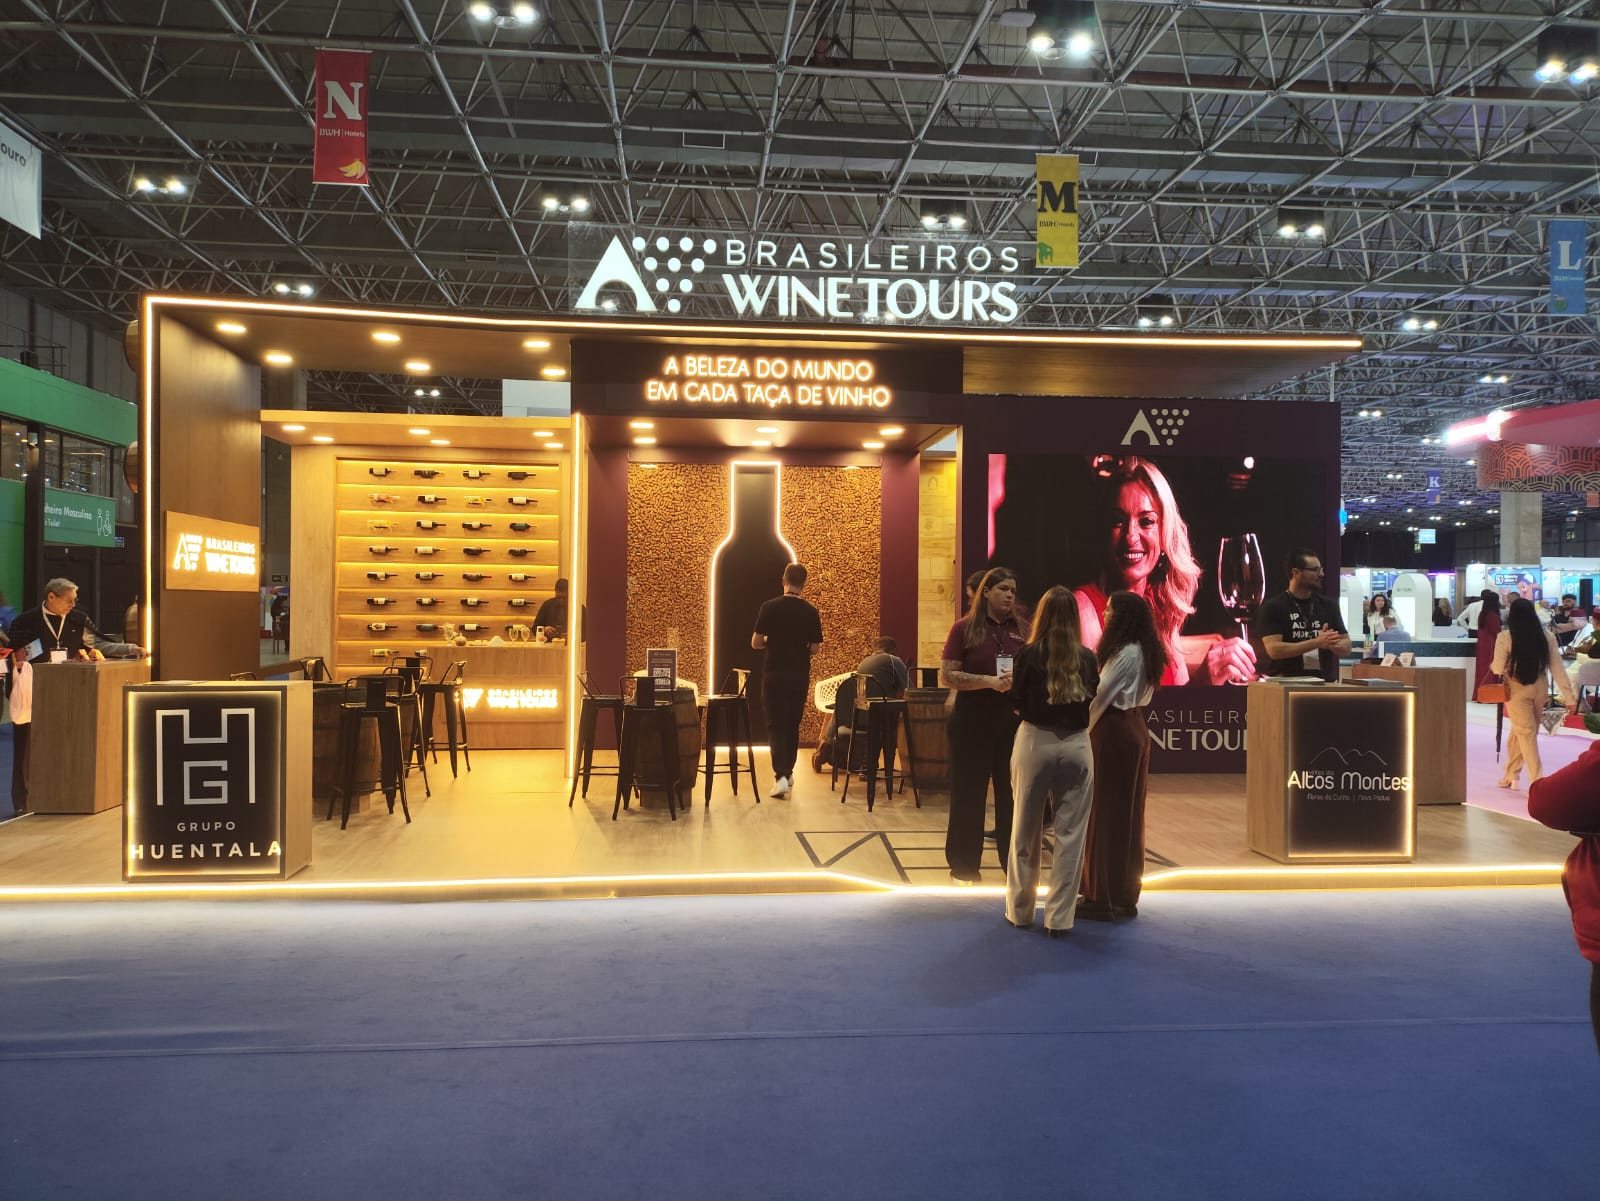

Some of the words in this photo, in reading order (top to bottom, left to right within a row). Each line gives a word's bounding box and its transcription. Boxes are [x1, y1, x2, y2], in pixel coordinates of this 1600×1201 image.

[323, 81, 364, 120] N
[319, 128, 341, 137] BWH
[1037, 181, 1078, 213] M
[726, 239, 1019, 272] BRASILEIROS
[1557, 240, 1582, 271] L
[663, 355, 679, 375] A
[685, 355, 750, 378] BELEZA
[756, 358, 788, 379] DO
[793, 359, 874, 382] MUNDO
[647, 381, 678, 401] EM
[684, 382, 738, 403] CADA
[742, 384, 792, 408] TAÇA
[798, 385, 823, 406] DE
[827, 386, 892, 407] VINHO
[1429, 476, 1441, 488] K
[63, 506, 93, 520] Masculino
[1147, 710, 1248, 724] ASILEIR
[1287, 770, 1335, 790] Altos
[1341, 771, 1411, 792] Montes
[176, 821, 237, 832] GRUPO
[129, 840, 282, 860] HUENTALA
